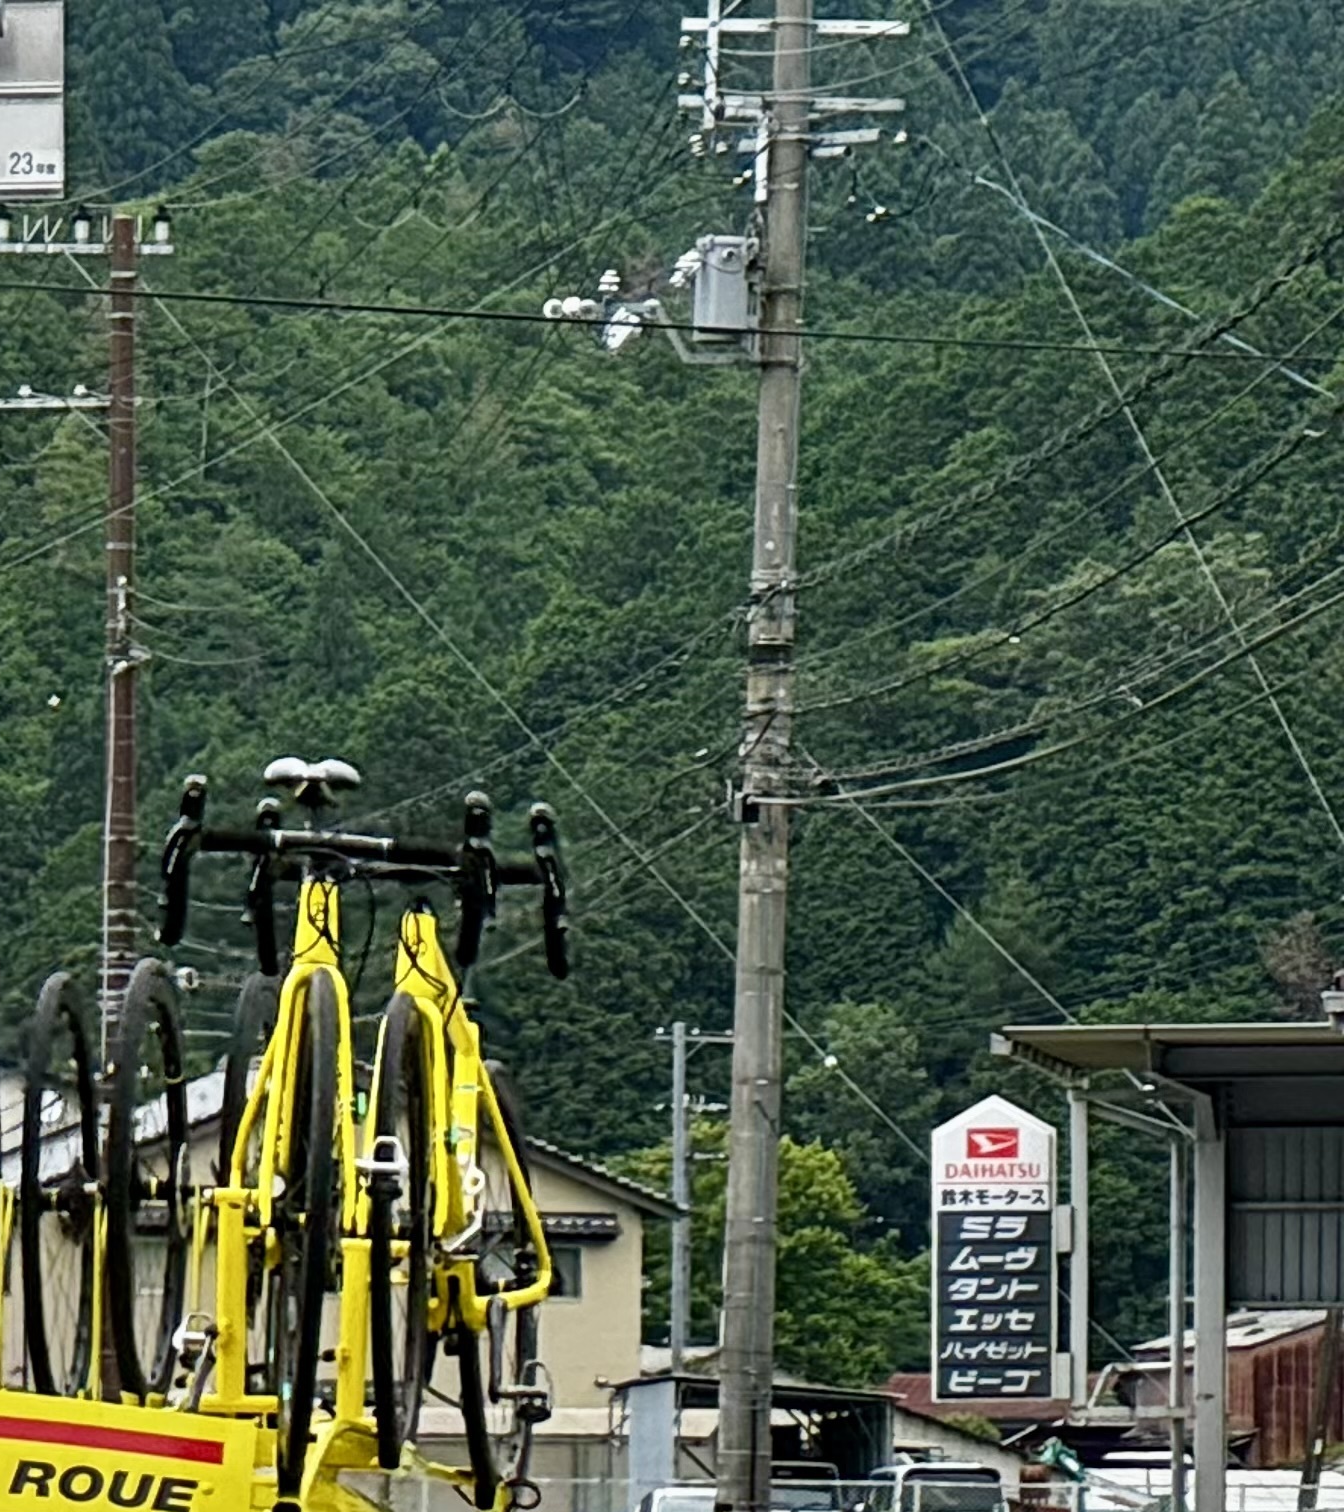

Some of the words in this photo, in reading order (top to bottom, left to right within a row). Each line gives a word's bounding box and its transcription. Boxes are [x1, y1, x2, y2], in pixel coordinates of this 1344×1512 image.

[945, 1163, 1041, 1179] DAIHATSU
[941, 1189, 1047, 1206] 鈴木モータース
[960, 1216, 1028, 1239] ミラ
[948, 1278, 1039, 1300] タント
[949, 1309, 1035, 1331] エッセ
[940, 1342, 1048, 1360] ハイゼット
